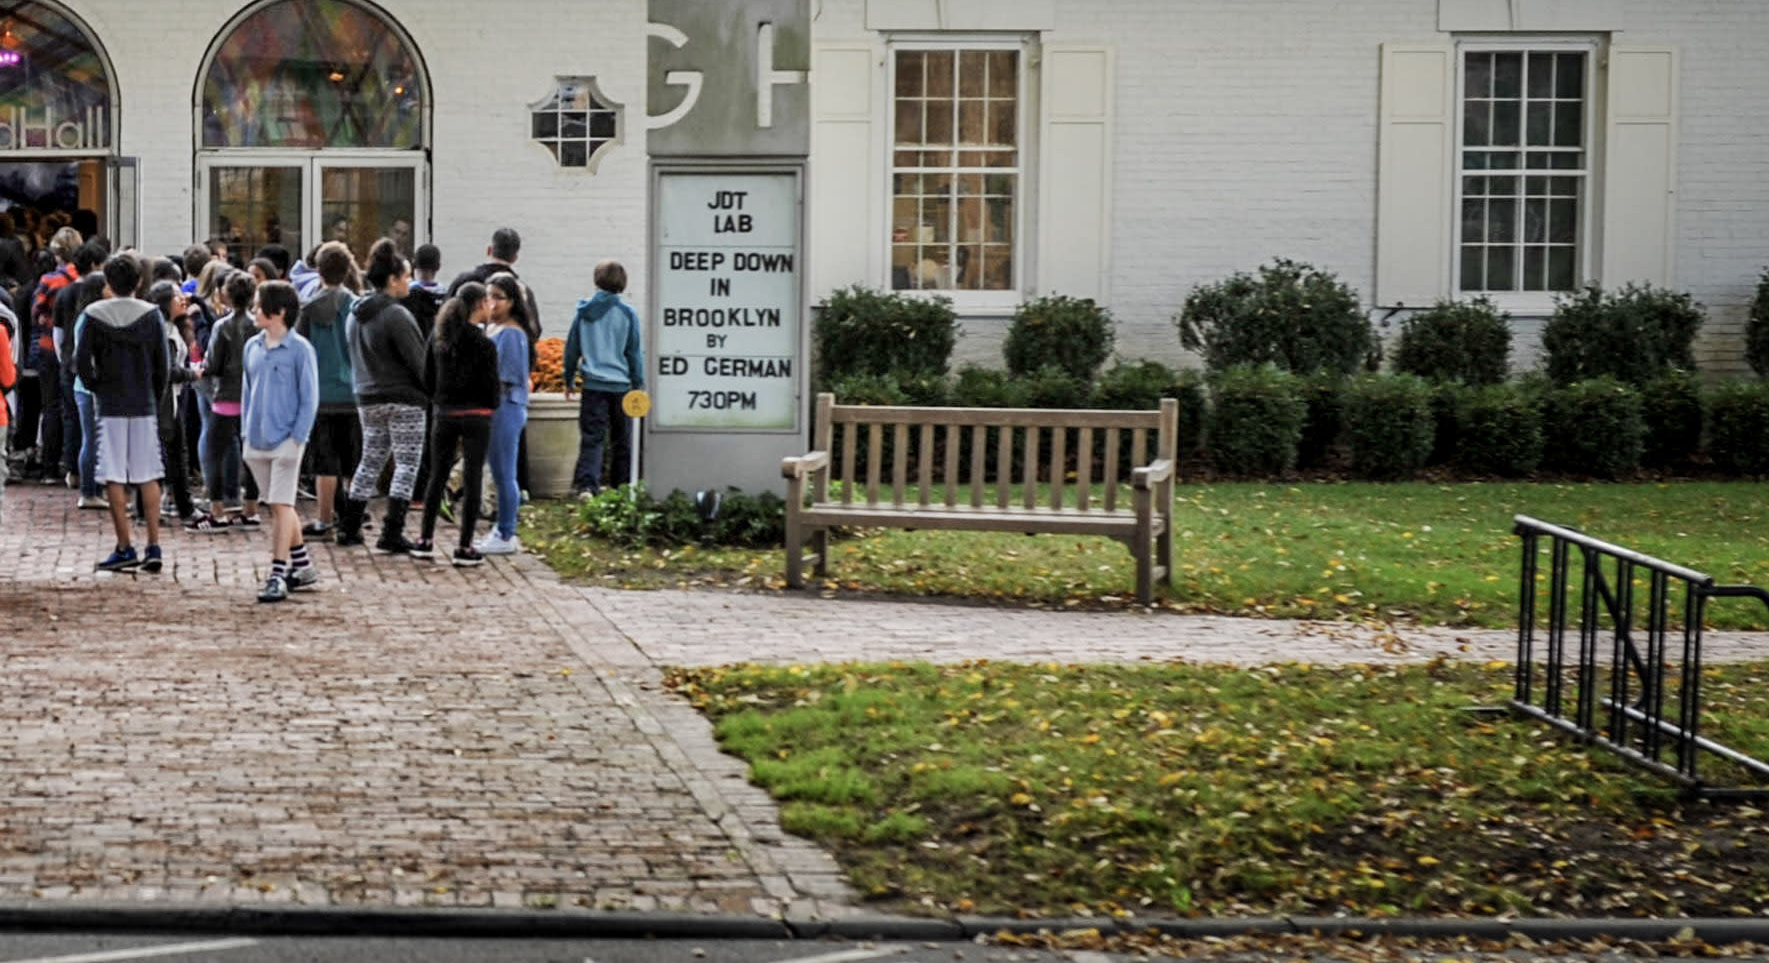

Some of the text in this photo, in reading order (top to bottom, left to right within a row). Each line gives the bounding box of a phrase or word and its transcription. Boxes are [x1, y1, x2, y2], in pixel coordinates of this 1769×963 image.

[707, 191, 748, 210] JDT
[714, 214, 753, 234] LAB
[670, 251, 794, 272] DEEP DOWN
[710, 277, 731, 297] IN
[663, 308, 781, 327] BROOKLYN
[706, 333, 728, 348] BY
[658, 356, 792, 378] ED GERMAN
[688, 391, 757, 410] 730PM
